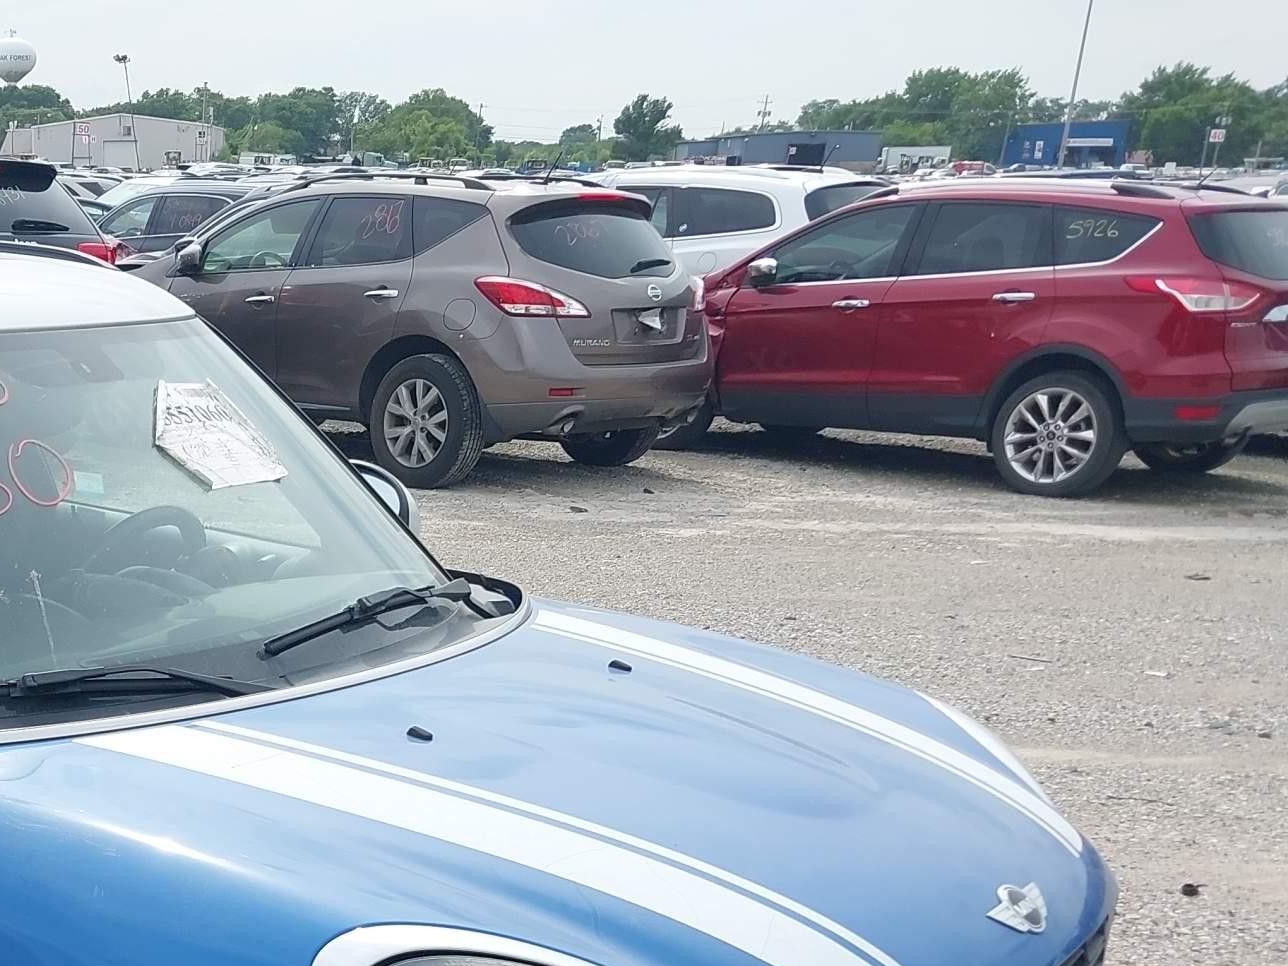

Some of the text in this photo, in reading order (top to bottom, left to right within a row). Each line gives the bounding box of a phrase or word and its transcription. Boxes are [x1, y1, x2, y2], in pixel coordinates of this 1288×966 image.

[9, 54, 32, 62] FOREST
[78, 124, 90, 134] 50
[1065, 219, 1119, 240] 5926
